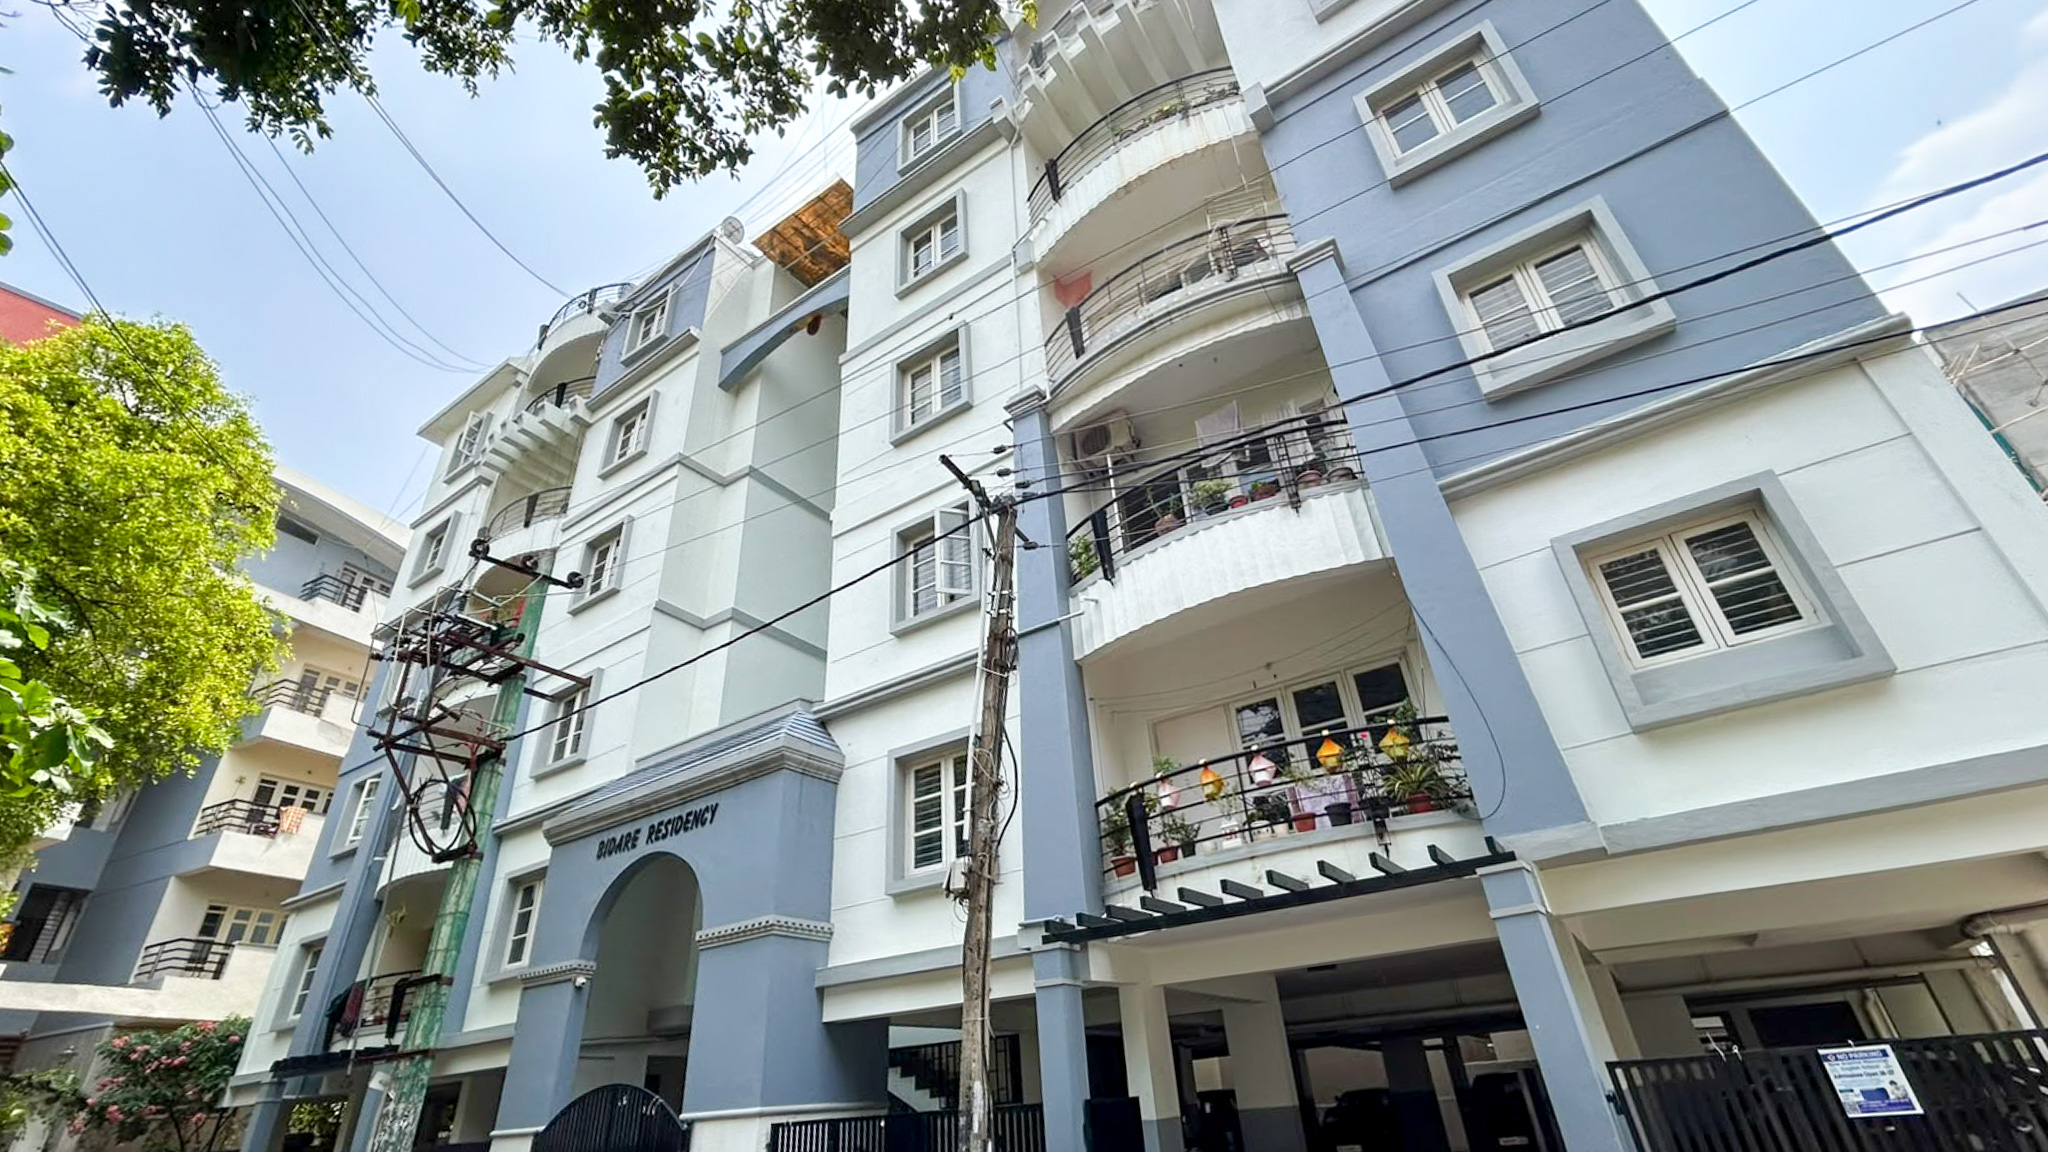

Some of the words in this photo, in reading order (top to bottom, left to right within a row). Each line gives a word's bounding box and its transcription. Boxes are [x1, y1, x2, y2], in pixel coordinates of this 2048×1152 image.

[596, 828, 641, 860] BIDARE
[646, 802, 719, 845] RESIDENCY
[1836, 1053, 1849, 1061] NO
[1849, 1050, 1883, 1060] PARKING
